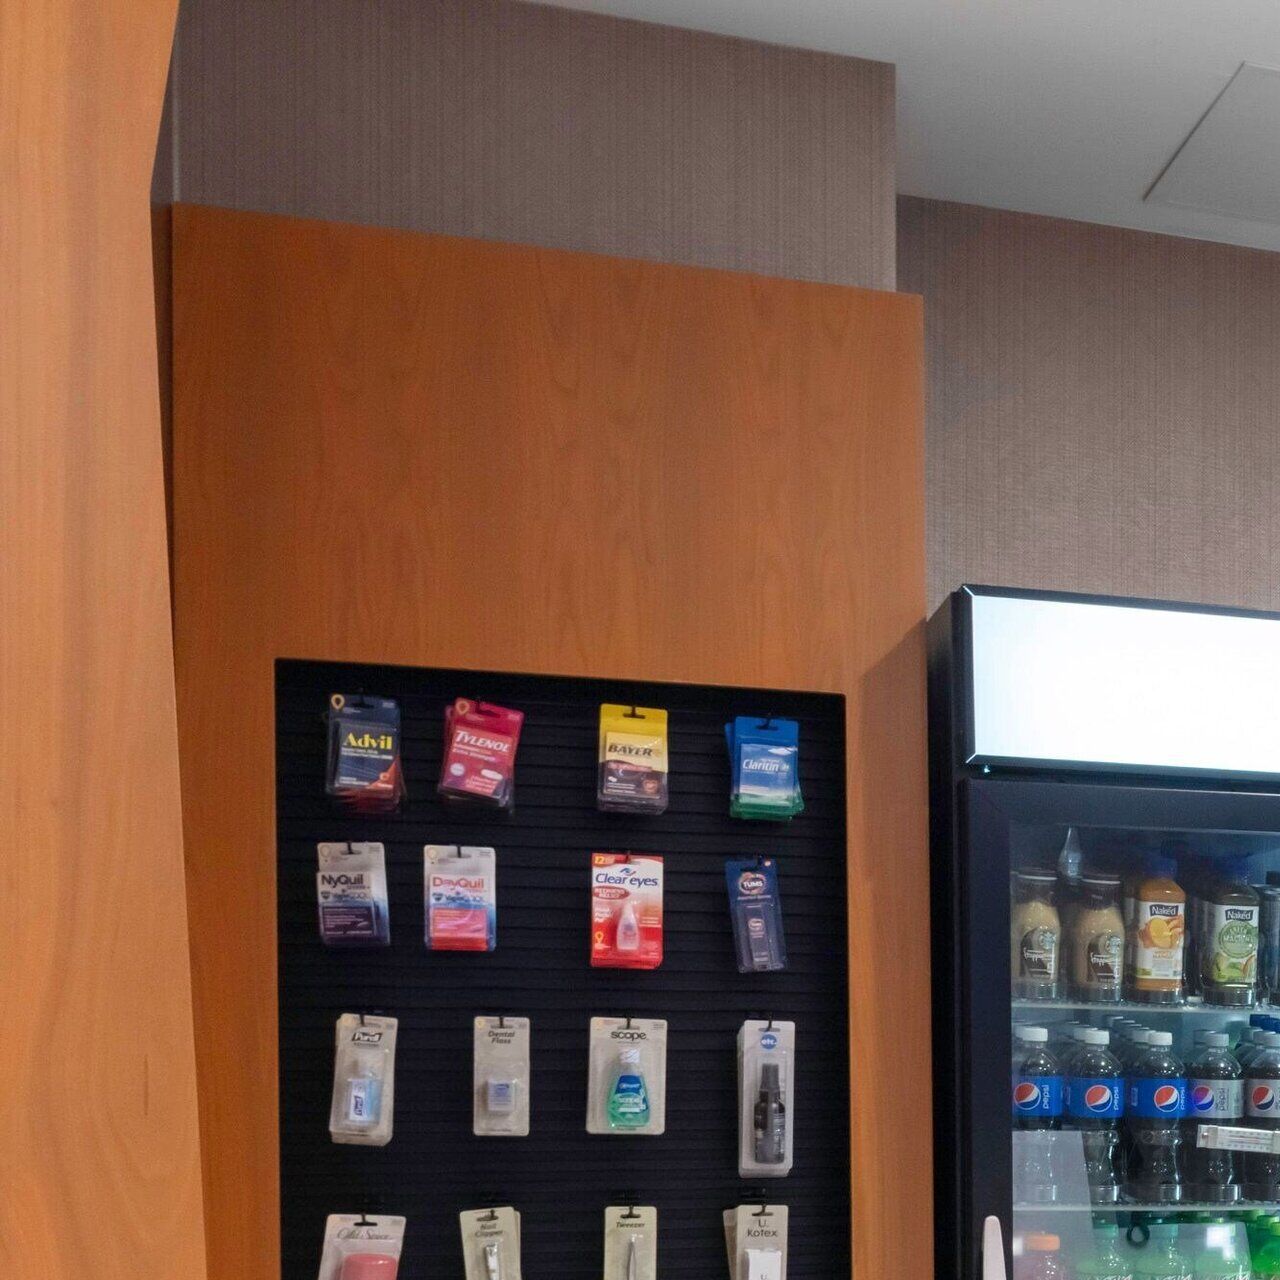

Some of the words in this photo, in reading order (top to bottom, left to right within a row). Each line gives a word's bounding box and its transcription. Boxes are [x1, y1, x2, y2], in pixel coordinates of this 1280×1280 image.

[343, 733, 392, 749] Advil
[455, 730, 512, 752] TYLENOL
[608, 744, 652, 757] BAYER
[742, 759, 779, 772] Claritin
[321, 874, 363, 888] NyQuil
[432, 877, 484, 890] DayQuil
[595, 873, 627, 885] Clear
[630, 876, 658, 888] eyes
[743, 879, 763, 888] TUMS
[1152, 906, 1177, 916] Naked
[1227, 911, 1252, 920] Naked
[611, 1031, 646, 1041] scope
[748, 1228, 778, 1237] Kotex
